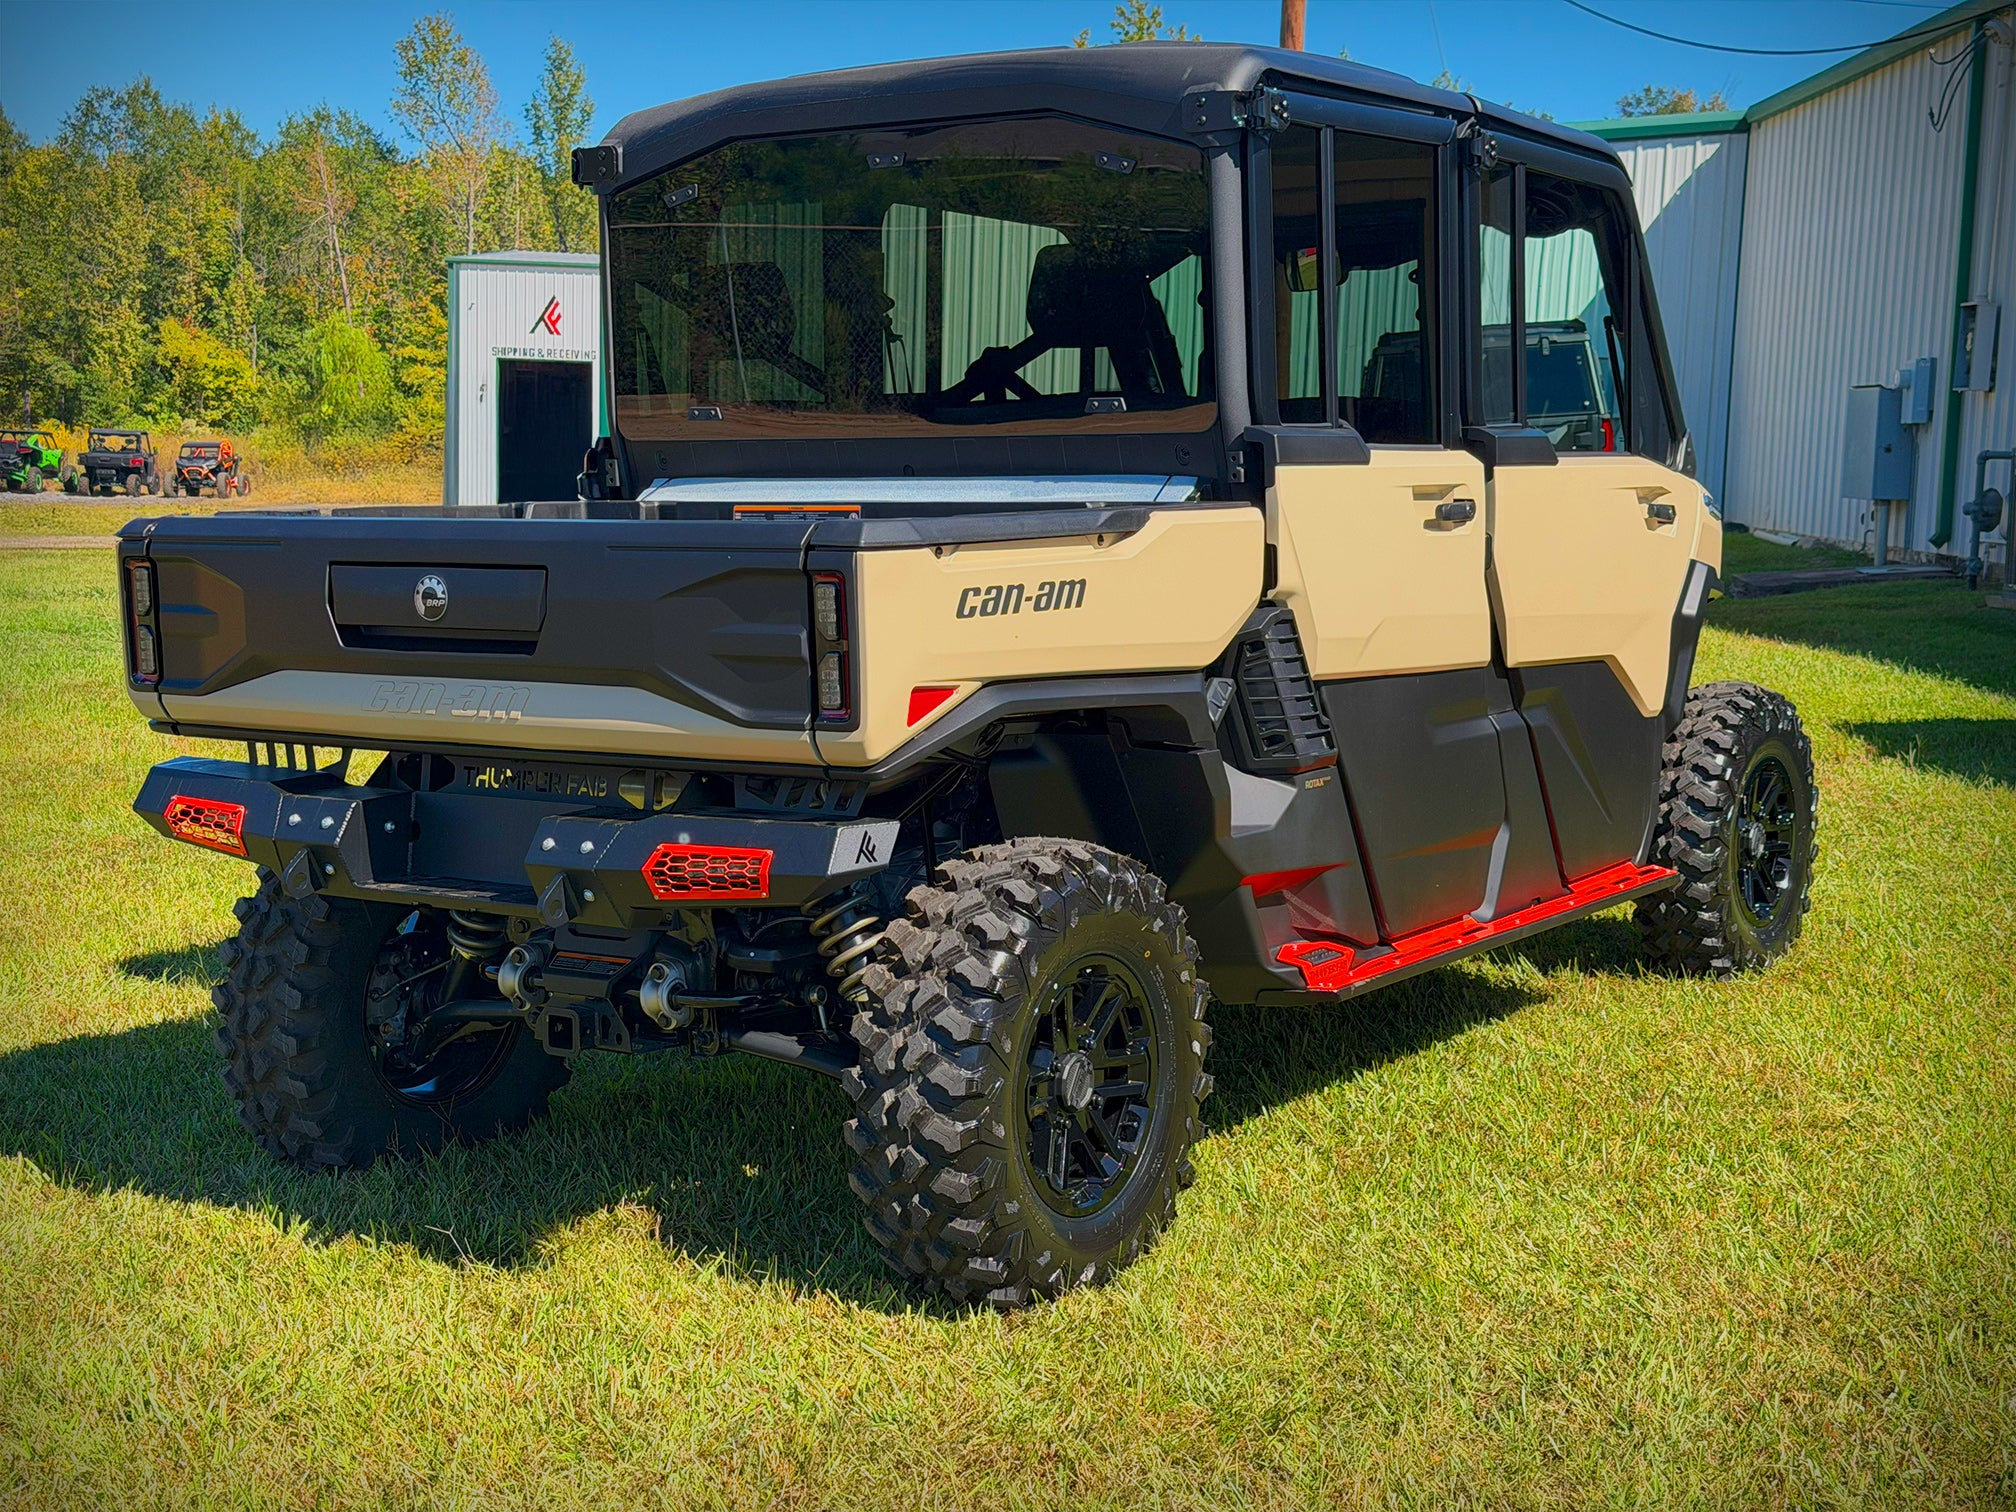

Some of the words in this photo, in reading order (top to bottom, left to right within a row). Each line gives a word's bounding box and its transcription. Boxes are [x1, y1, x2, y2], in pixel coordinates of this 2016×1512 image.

[491, 346, 536, 358] SHIPPING
[537, 348, 545, 358] &
[546, 348, 597, 360] RECEIVING
[426, 599, 446, 607] BRP
[956, 578, 1087, 619] can-am
[361, 680, 531, 720] can-am
[464, 765, 562, 794] THUMPER
[567, 773, 608, 797] FAB
